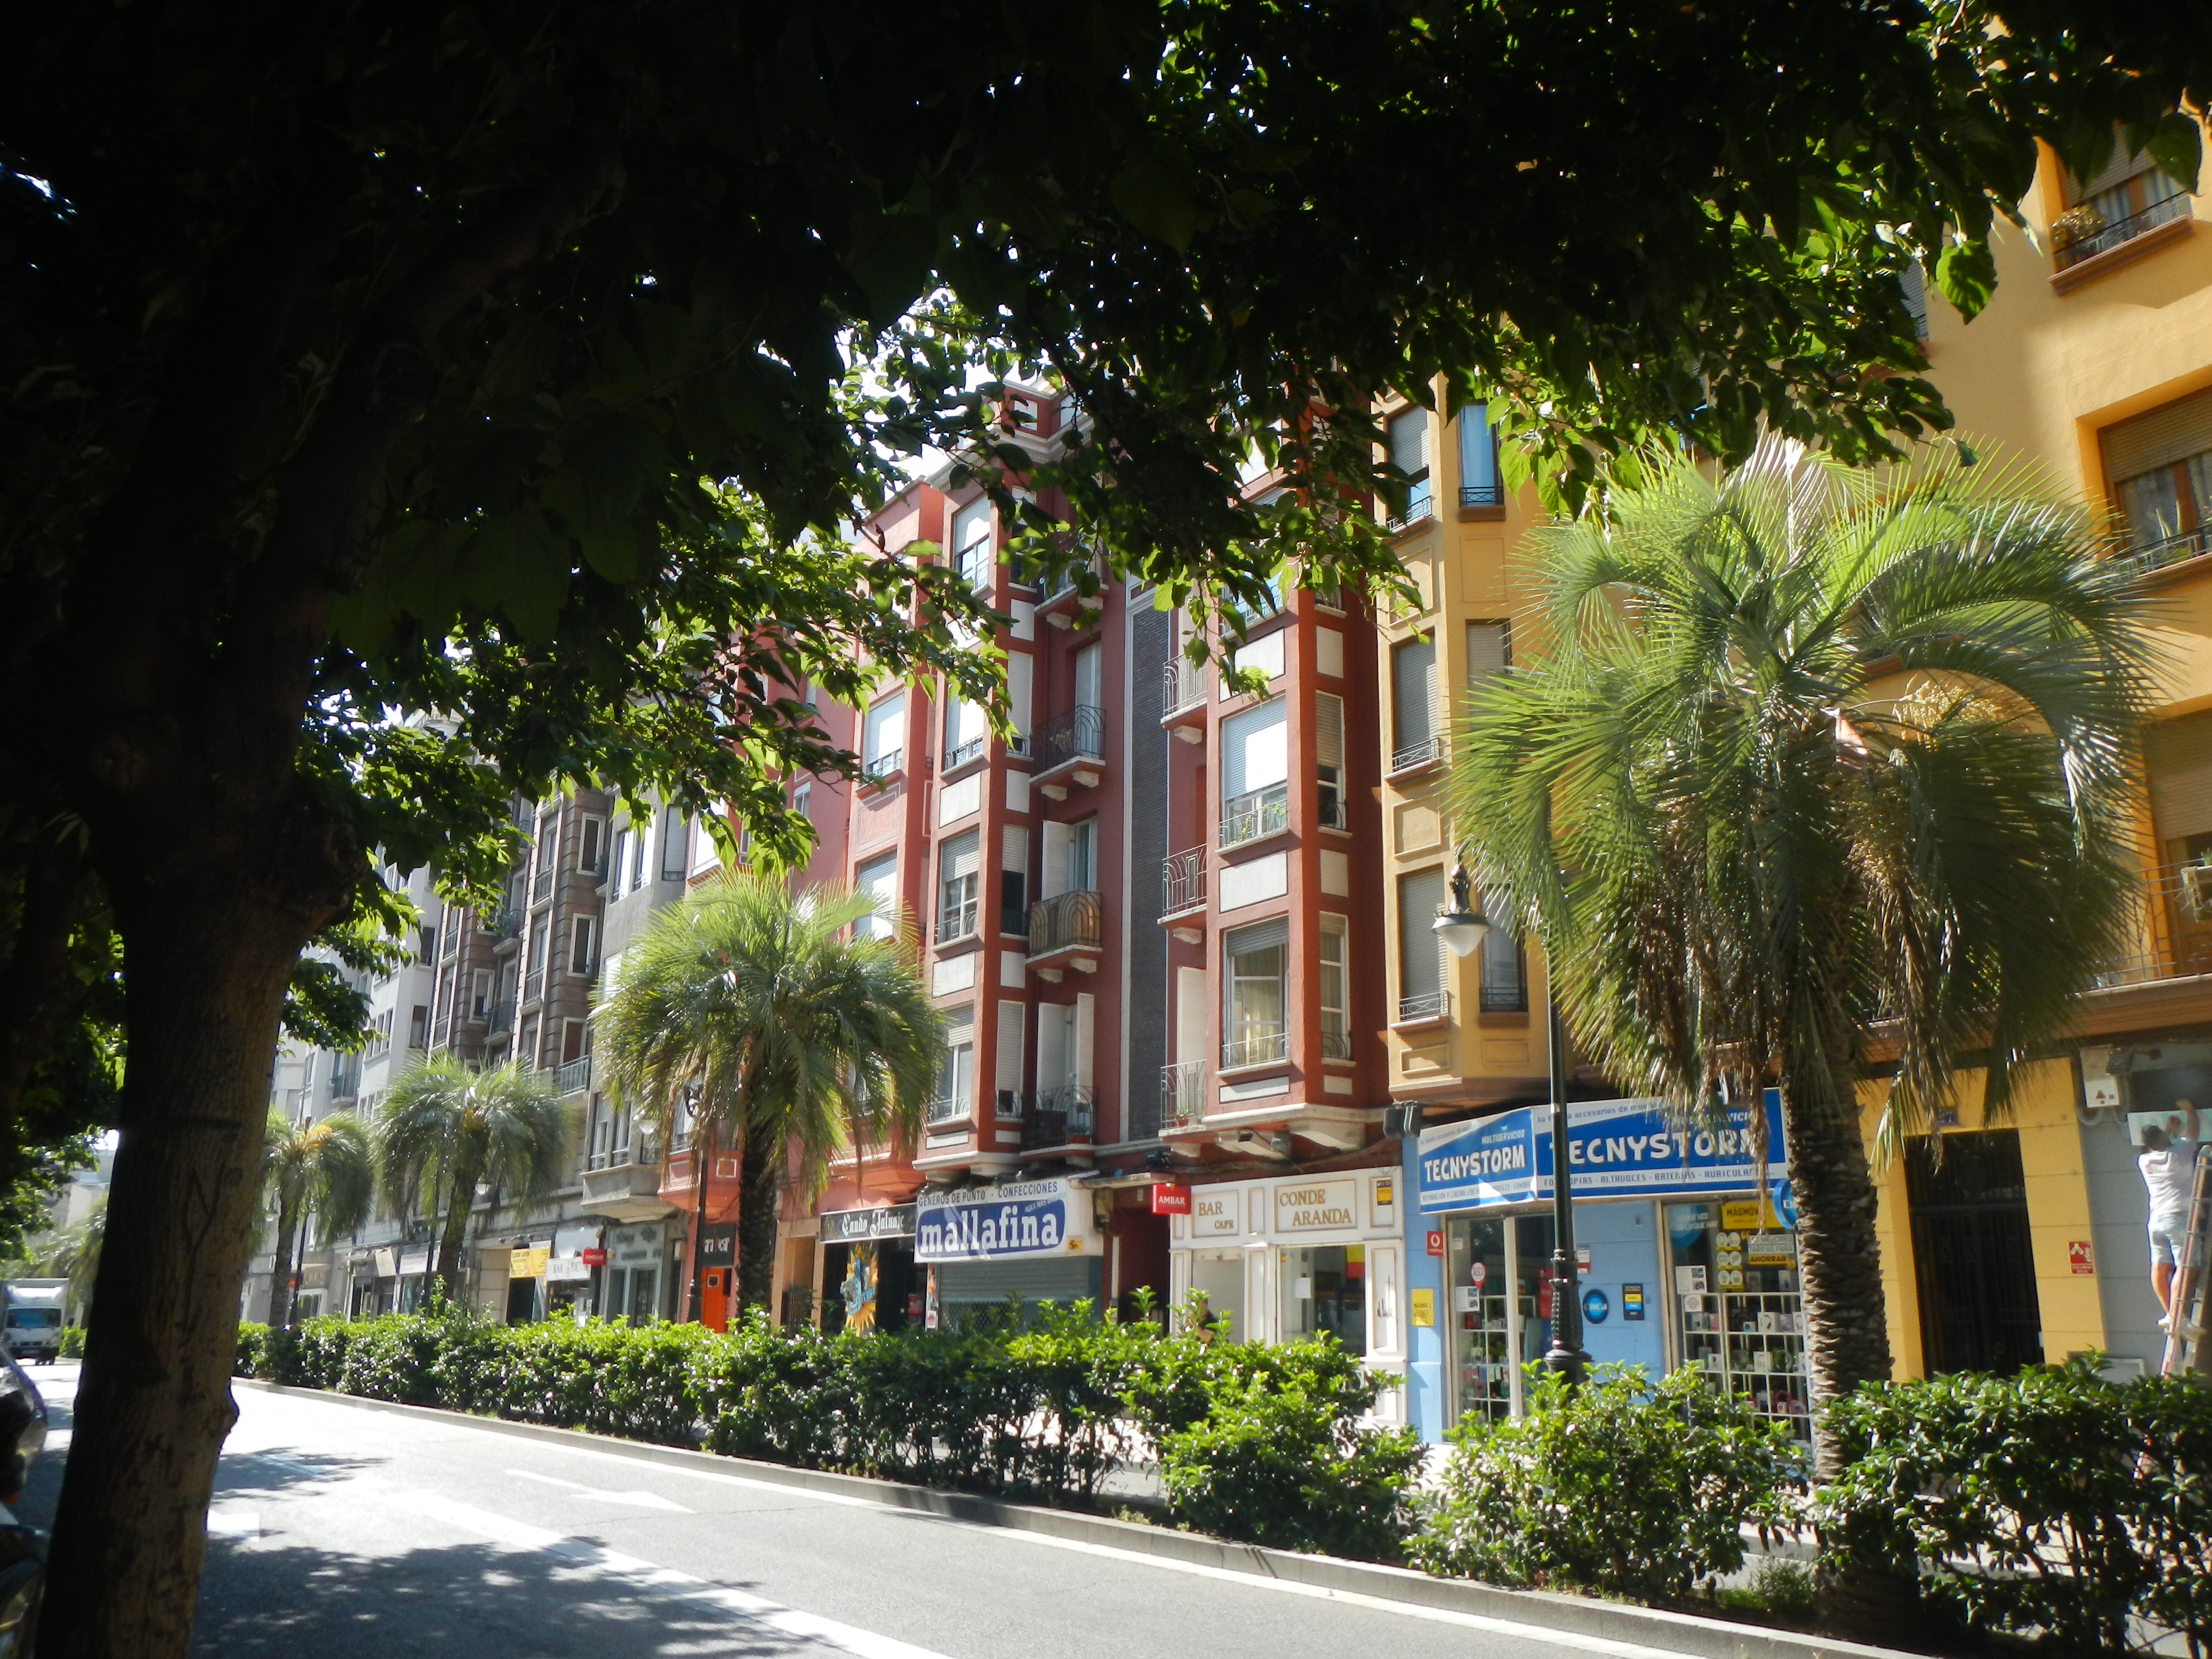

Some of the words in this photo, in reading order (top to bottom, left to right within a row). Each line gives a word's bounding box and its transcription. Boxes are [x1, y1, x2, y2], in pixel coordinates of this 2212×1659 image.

[1575, 1107, 1616, 1118] accesorios
[1618, 1105, 1628, 1113] de
[1481, 1129, 1525, 1145] MULTISERVICIOS
[1550, 1128, 1763, 1165] ECNYSTOR
[1424, 1144, 1526, 1182] TECNYSTORM
[1544, 1176, 1592, 1186] FOOPIAS
[1600, 1174, 1646, 1183] ALTAVOCES
[951, 1192, 960, 1203] DE
[962, 1190, 986, 1202] PUNTO
[998, 1181, 1058, 1198] CONFECCIONES
[1279, 1189, 1325, 1206] CONDE
[1158, 1195, 1185, 1205] AMBAR
[1198, 1201, 1223, 1216] BAR
[1726, 1205, 1764, 1216] MÁSMÓV
[1292, 1208, 1352, 1226] ARANDA
[920, 1205, 1059, 1253] mallafina
[1750, 1254, 1786, 1262] AHORRAR
[553, 1263, 563, 1274] BAR
